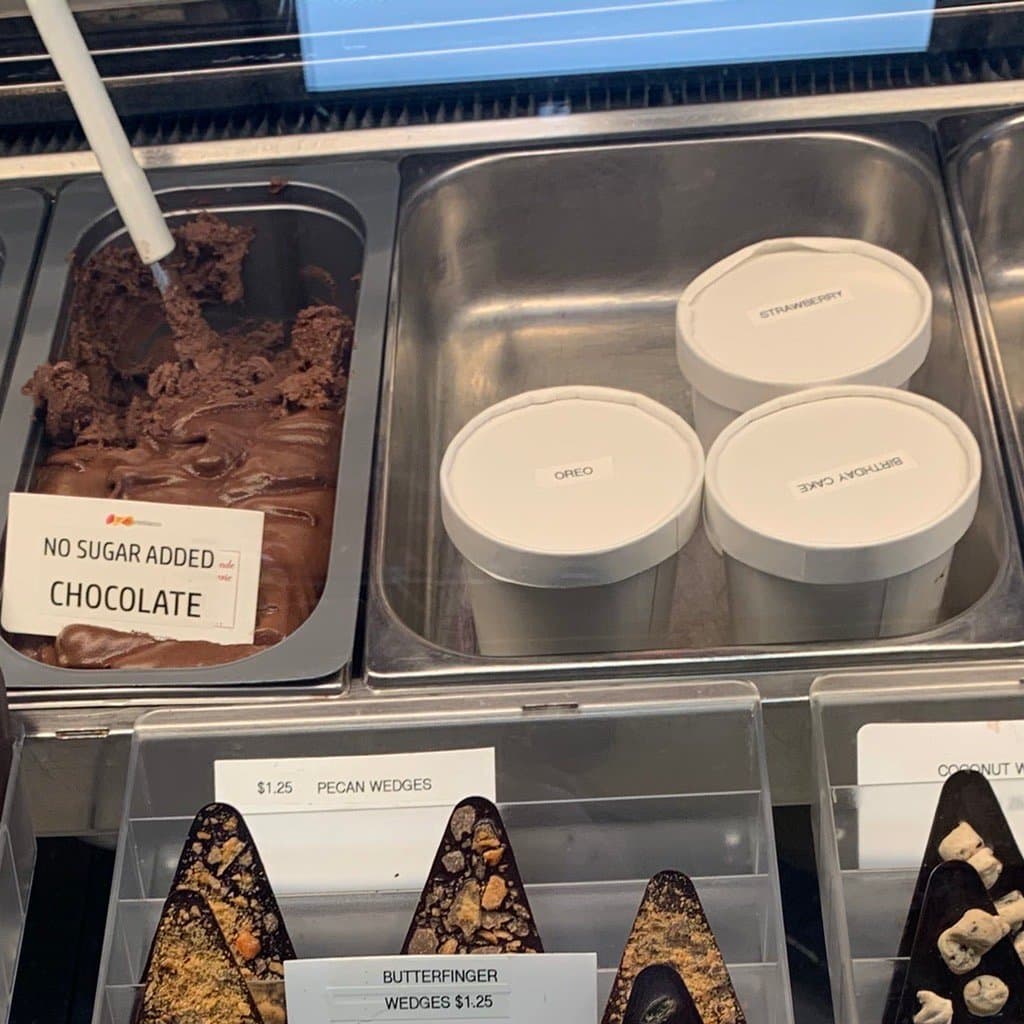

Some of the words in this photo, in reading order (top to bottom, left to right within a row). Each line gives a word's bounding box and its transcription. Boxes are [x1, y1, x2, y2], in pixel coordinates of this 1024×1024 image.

[759, 290, 843, 319] STRAWBERRY
[554, 466, 593, 480] OREO
[838, 456, 904, 482] BIRTHDAY
[797, 476, 835, 494] CAKE
[43, 537, 71, 558] NO
[76, 539, 141, 563] SUGAR
[145, 545, 215, 569] ADDED
[50, 580, 203, 618] CHOCOLATE
[257, 780, 293, 795] $1.25
[317, 780, 365, 794] PECAN
[369, 778, 432, 793] WEDGES
[383, 969, 498, 984] BUTTERFINGER
[384, 995, 451, 1011] WEDGES
[455, 994, 494, 1010] $1.25
